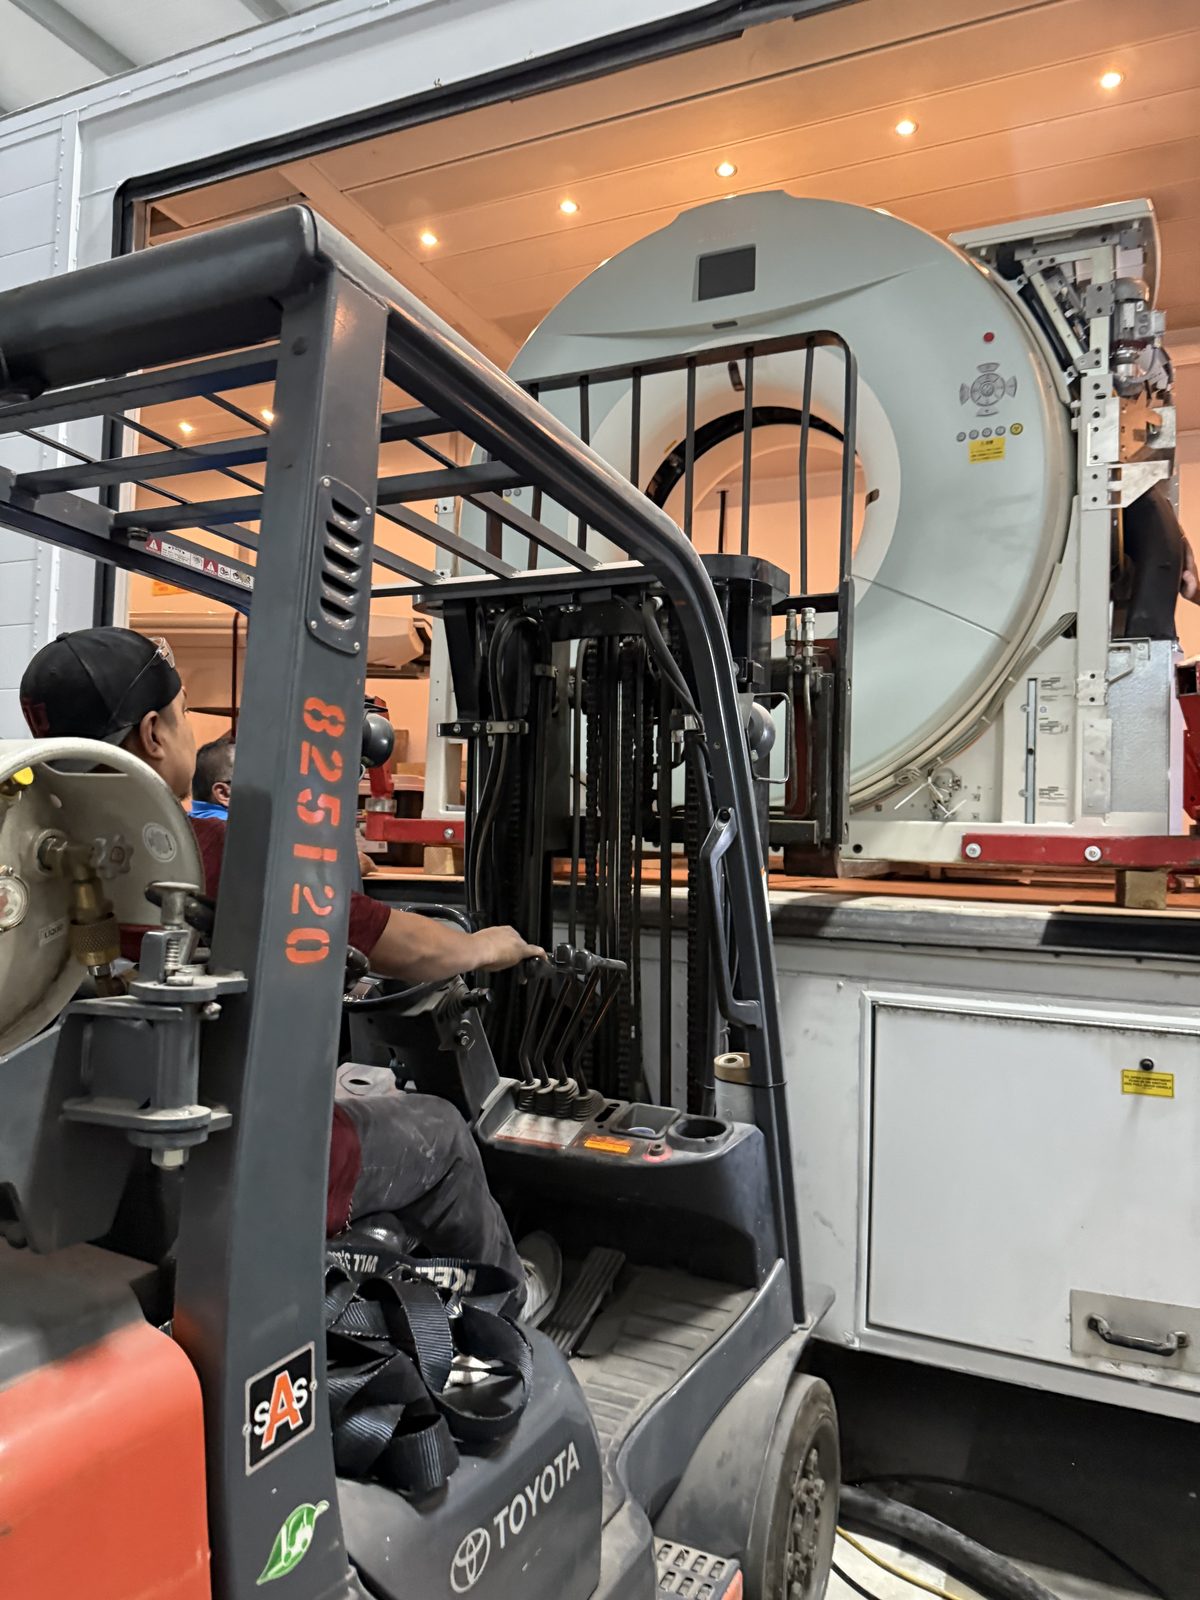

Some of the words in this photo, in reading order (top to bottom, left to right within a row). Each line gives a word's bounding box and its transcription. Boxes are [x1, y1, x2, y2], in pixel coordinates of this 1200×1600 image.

[285, 696, 346, 964] 825120
[353, 1253, 379, 1273] WLL
[253, 1369, 308, 1451] SAS
[493, 1441, 581, 1549] TOYOTA
